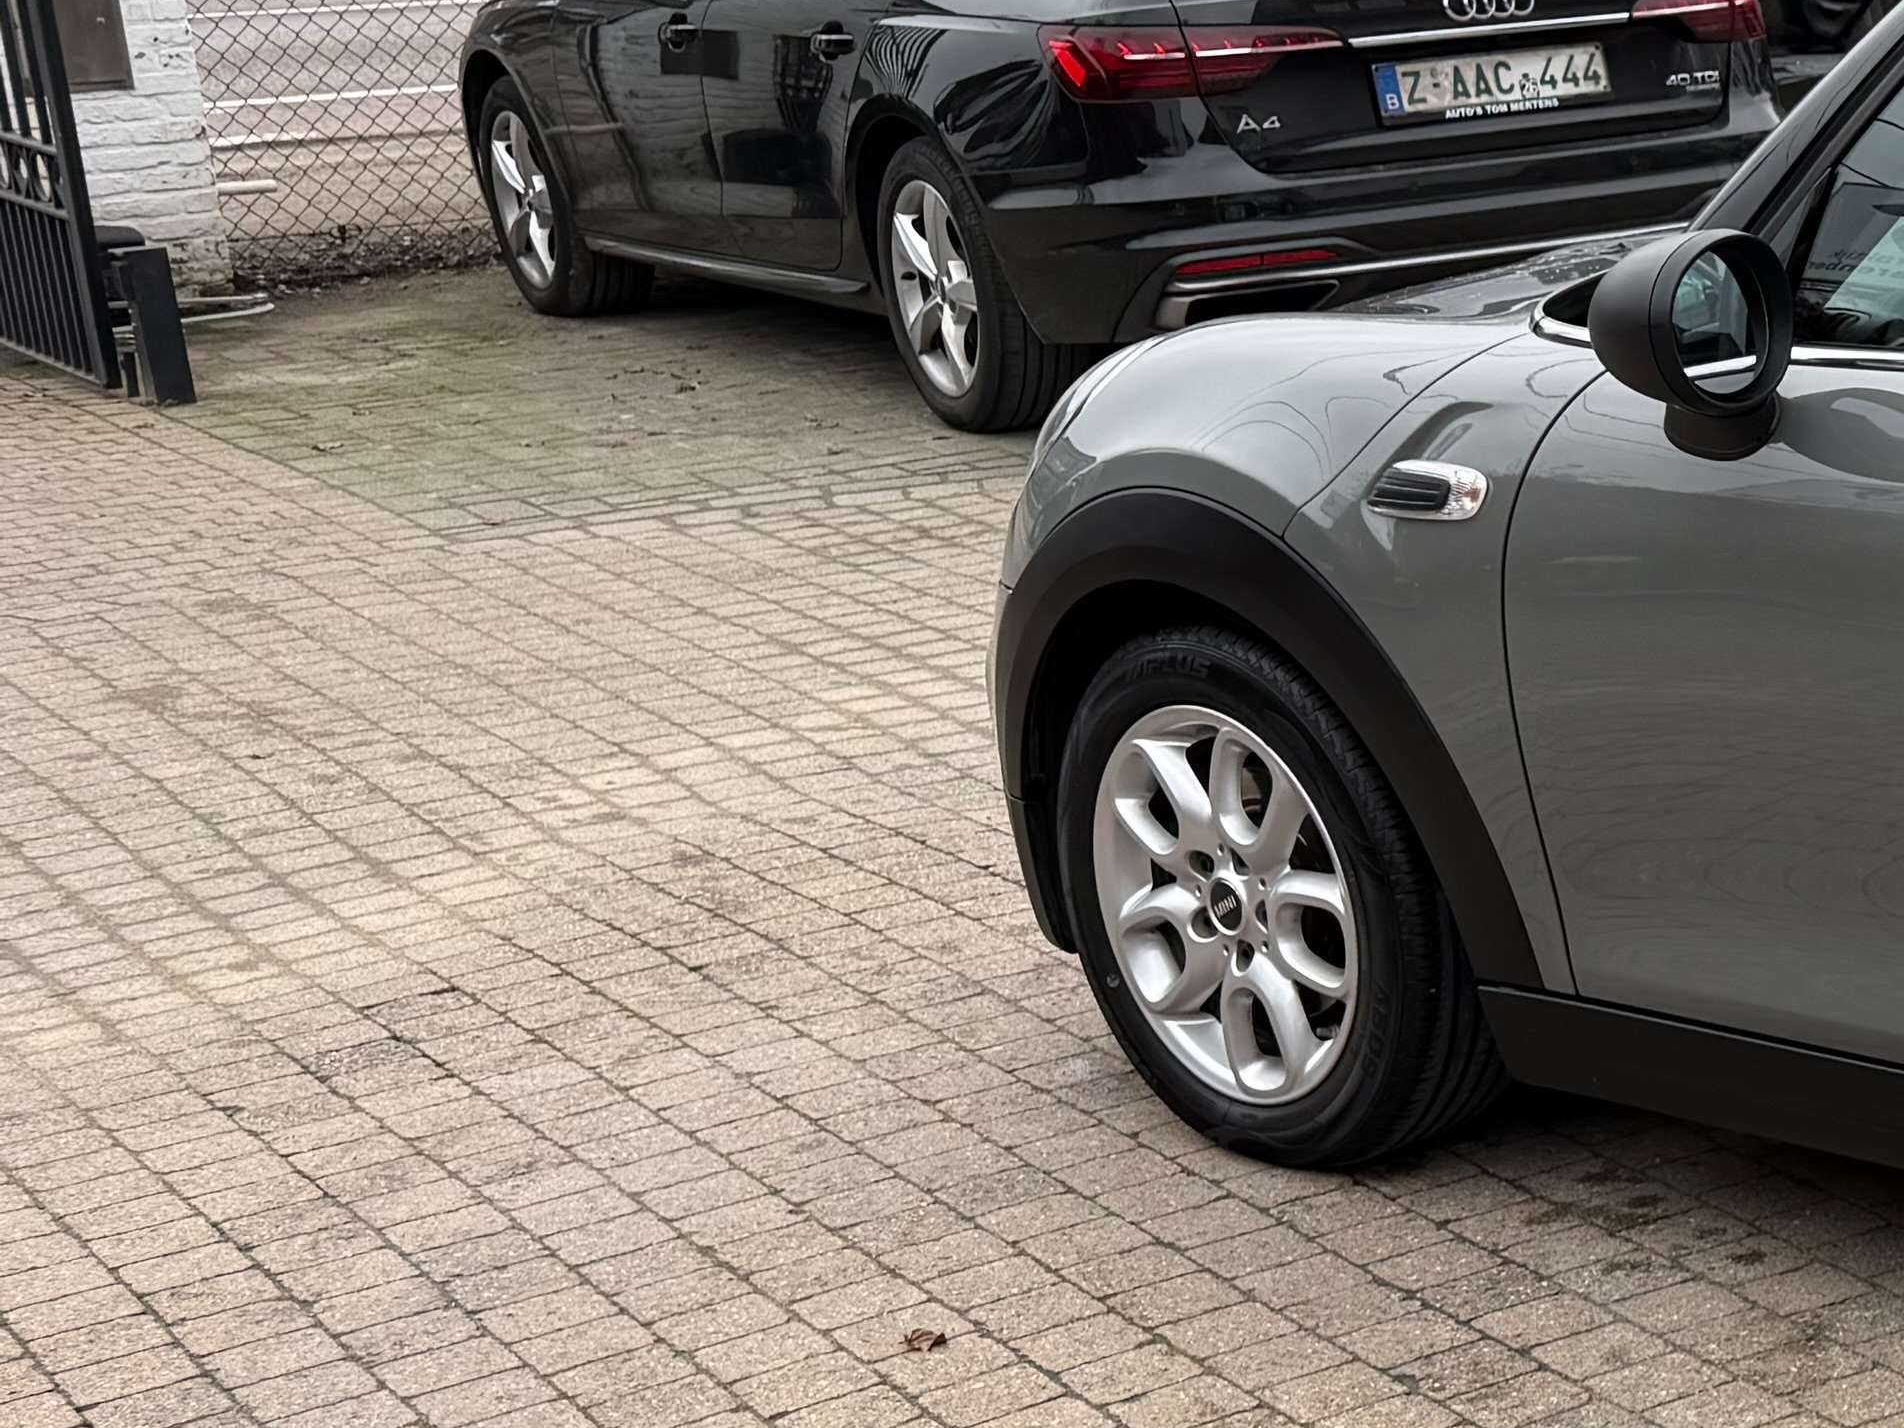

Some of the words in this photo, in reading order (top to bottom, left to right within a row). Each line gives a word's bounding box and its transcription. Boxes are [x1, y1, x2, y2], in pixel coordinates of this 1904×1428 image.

[1385, 93, 1400, 110] B
[1486, 104, 1509, 116] TOM
[1236, 113, 1281, 134] A4
